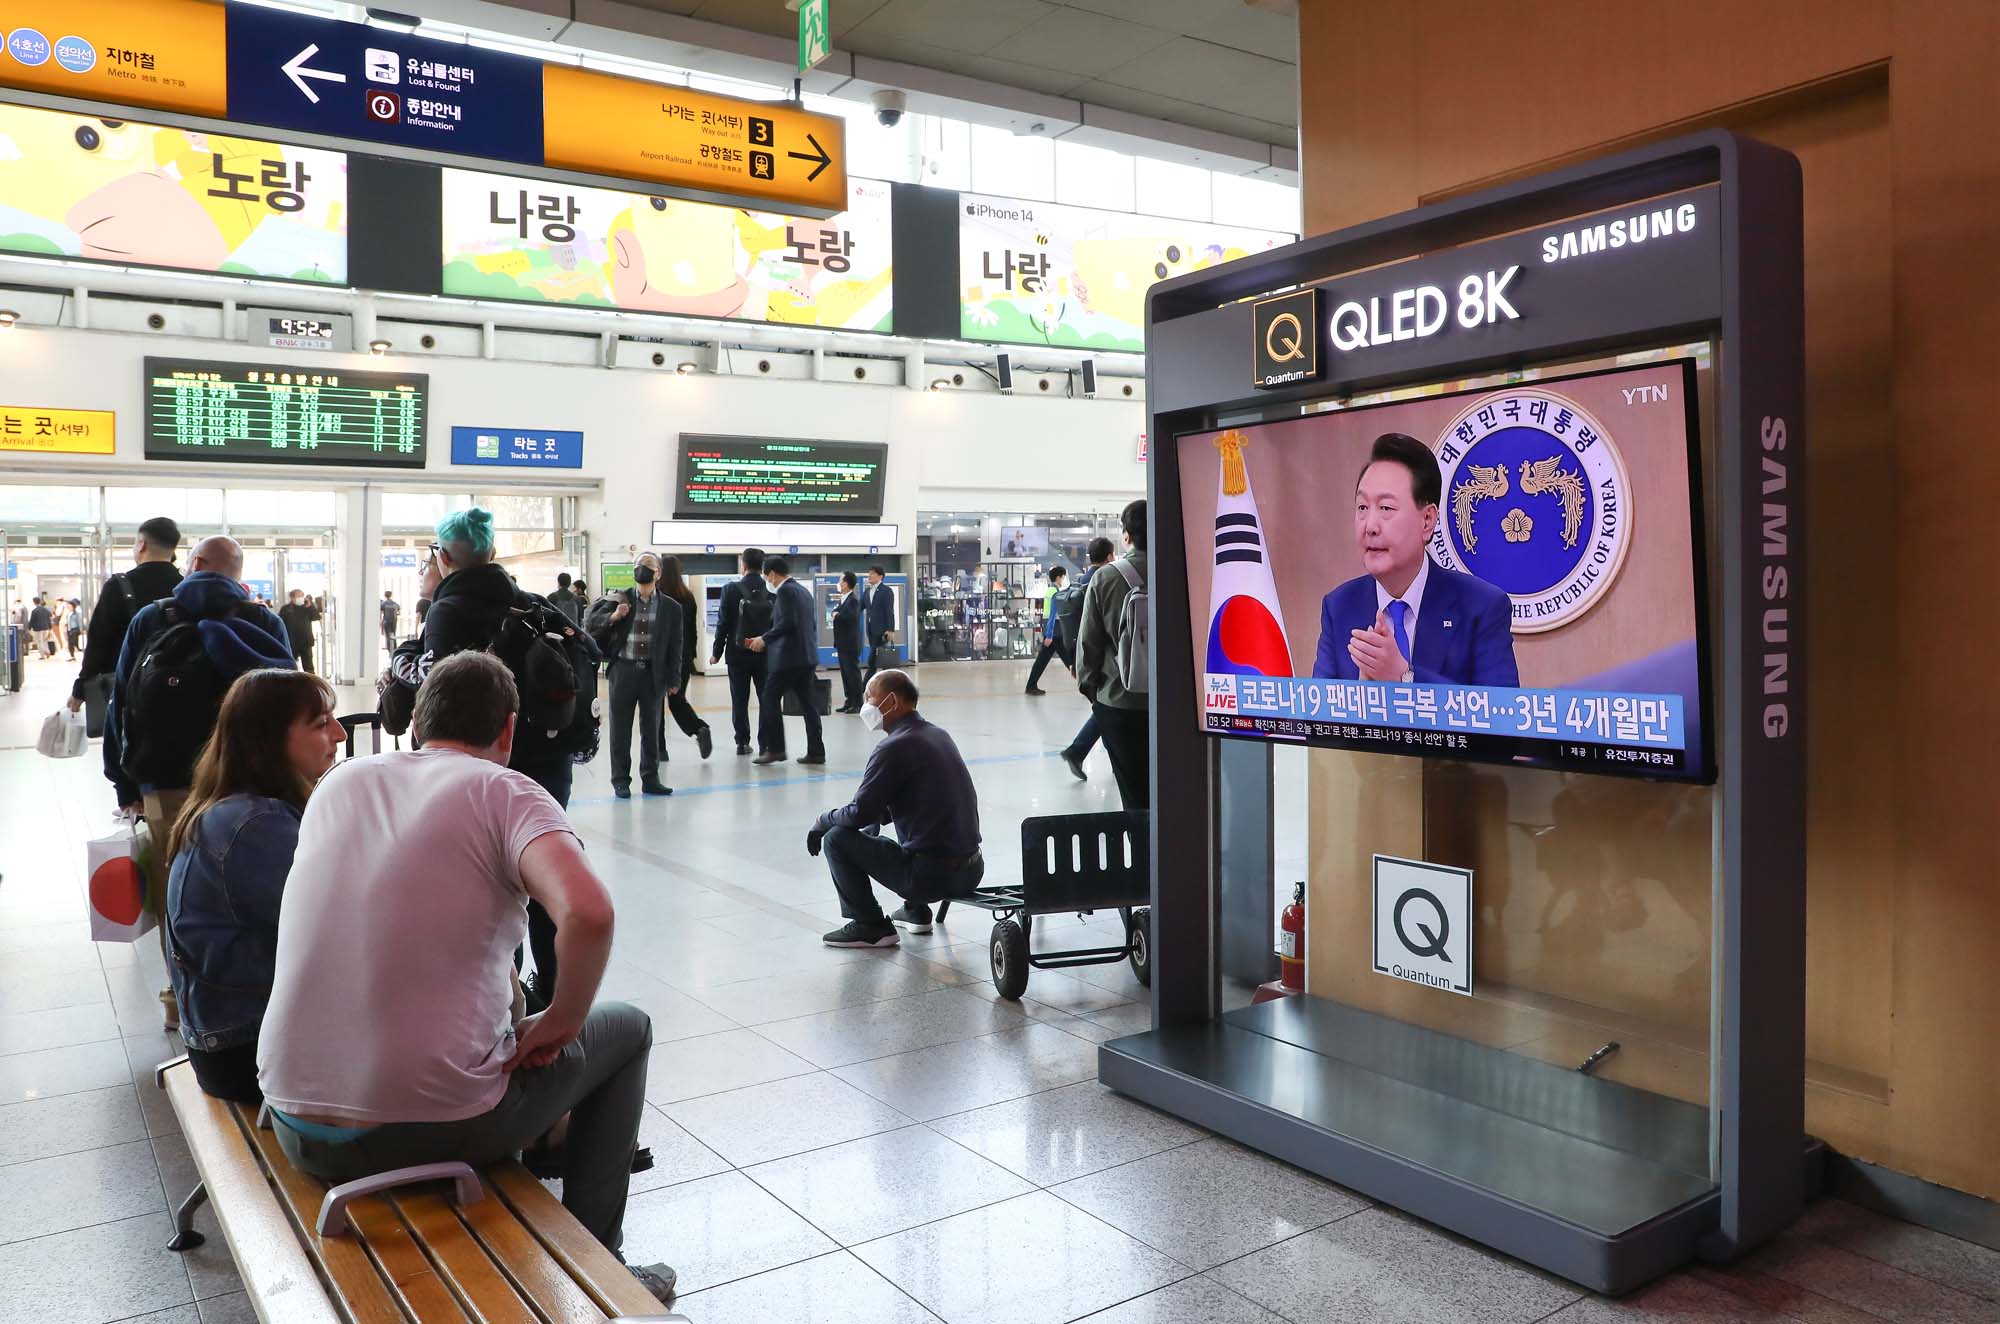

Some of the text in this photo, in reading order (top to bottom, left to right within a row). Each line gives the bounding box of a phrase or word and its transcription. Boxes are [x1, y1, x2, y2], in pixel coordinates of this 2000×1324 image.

[12, 37, 46, 54] 4호선
[57, 44, 93, 61] 경의선
[19, 51, 34, 59] Line
[106, 47, 156, 71] 지하철
[107, 67, 137, 80] Metro
[406, 58, 475, 85] 유실물센터
[408, 76, 461, 92] Lost & Found
[406, 97, 461, 121] 종합안내
[661, 103, 743, 131] 나가는 곳(서부)
[407, 116, 455, 131] Information
[701, 126, 716, 136] Way
[716, 129, 728, 138] out
[755, 122, 768, 142] 3
[640, 150, 693, 165] Airport Railroad
[699, 143, 743, 161] 공항철도
[207, 153, 312, 213] 노랑
[489, 189, 582, 243] 나랑
[976, 203, 1034, 222] iPhone 14
[1541, 203, 1697, 264] SAMSUNG
[782, 226, 856, 273] 노랑
[983, 249, 1051, 293] 나랑
[1329, 264, 1521, 352] QLED 8K
[1266, 312, 1306, 363] Q
[1265, 370, 1304, 386] Quantum
[208, 398, 226, 408] KTX
[1621, 384, 1669, 405] YTN
[208, 408, 226, 417] KTX
[0, 415, 22, 435] 는
[208, 418, 226, 427] KTX
[2, 437, 34, 447] Arrival
[208, 437, 226, 447] KTX
[514, 436, 538, 451] 타는
[544, 438, 556, 452] 곳
[510, 451, 529, 460] Tracks
[1600, 477, 1617, 539] KOREA
[1593, 541, 1611, 564] OF
[1760, 414, 1789, 739] SAMSUNG
[1534, 563, 1600, 617] REPUBLIC
[926, 608, 954, 617] KORAIL
[1511, 604, 1533, 618] HE
[1210, 677, 1230, 692] 뉴스
[1205, 693, 1237, 709] LIVE
[1242, 680, 1322, 717] 코로나19
[1325, 684, 1389, 722] 팬데믹
[1393, 687, 1439, 726] 극복
[1564, 697, 1670, 743] 4개월만
[1254, 719, 1277, 732] 확진자
[1277, 720, 1295, 734] 격리,
[1296, 722, 1312, 735] 오늘
[1445, 734, 1456, 748] 할
[1457, 735, 1468, 749] 듯
[1570, 746, 1587, 758] 제공
[1604, 748, 1675, 766] 유진투자증권
[1393, 887, 1454, 964] Q
[1392, 964, 1451, 990] Quantum
